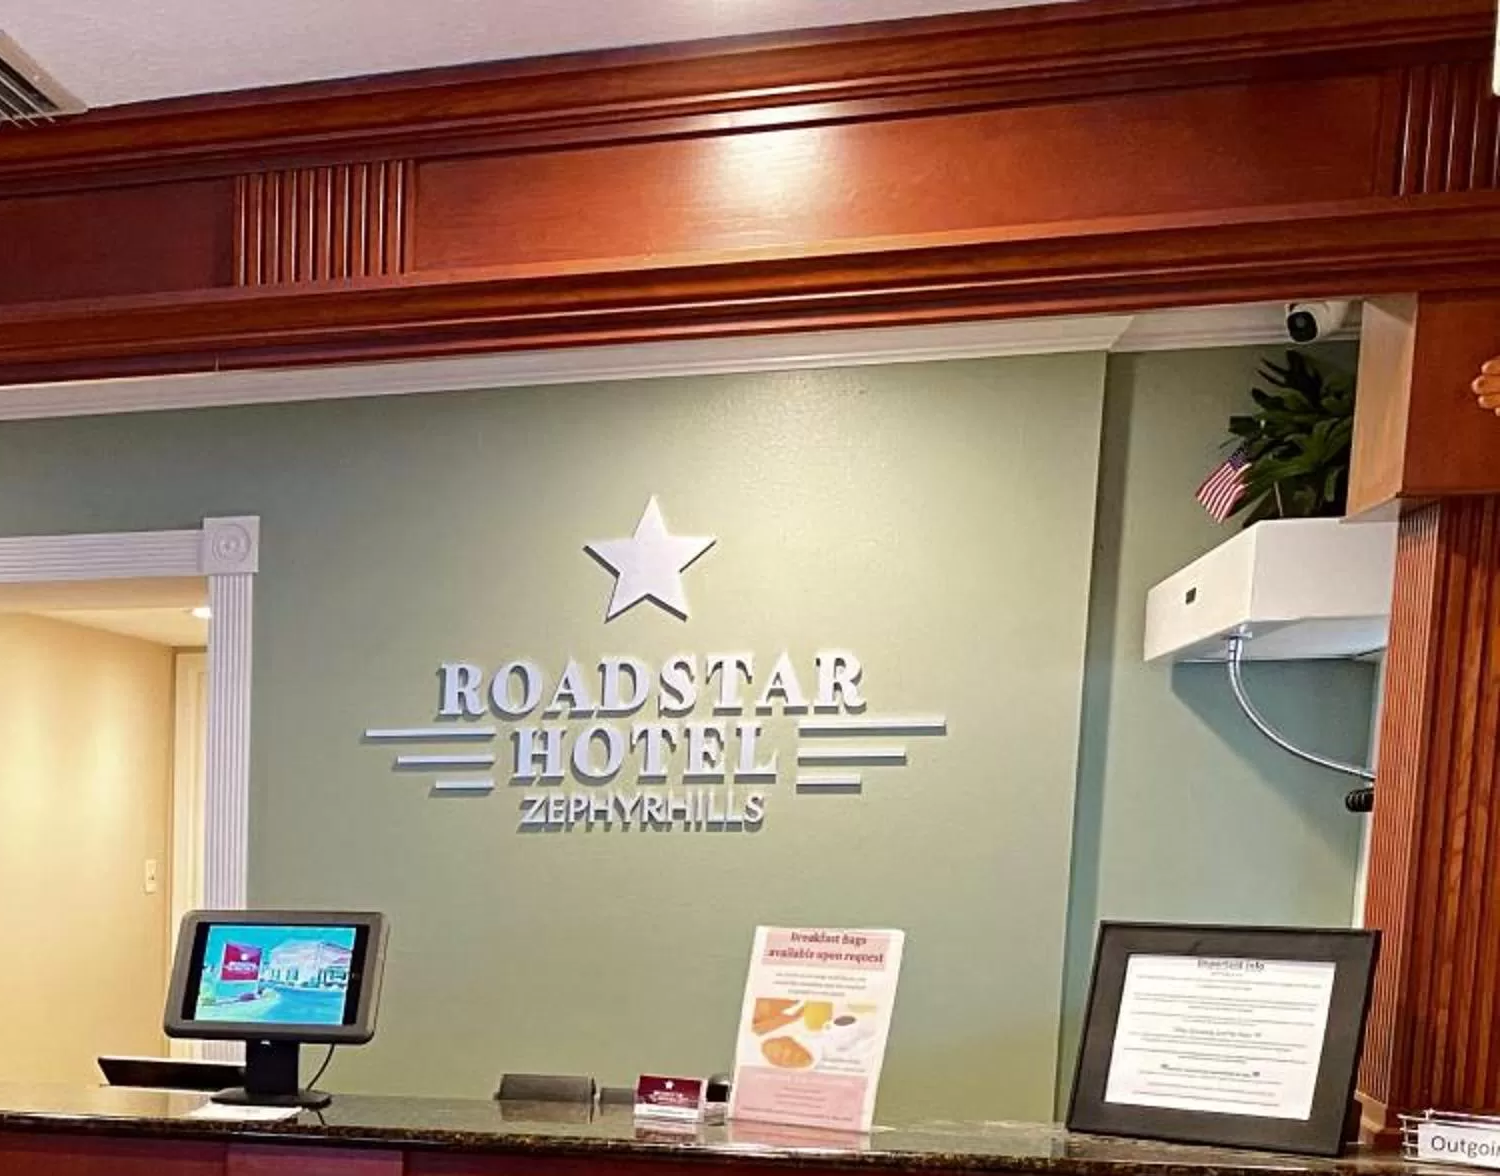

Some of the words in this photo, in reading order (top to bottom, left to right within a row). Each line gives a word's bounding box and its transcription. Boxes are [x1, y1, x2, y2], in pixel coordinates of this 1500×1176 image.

[438, 648, 867, 718] ROADSTAR
[510, 720, 777, 783] HOTEL
[519, 792, 764, 829] ZEPHYRHILLS
[790, 930, 841, 943] Breakfast
[768, 948, 814, 959] available
[815, 951, 842, 962] upon
[843, 953, 884, 964] request
